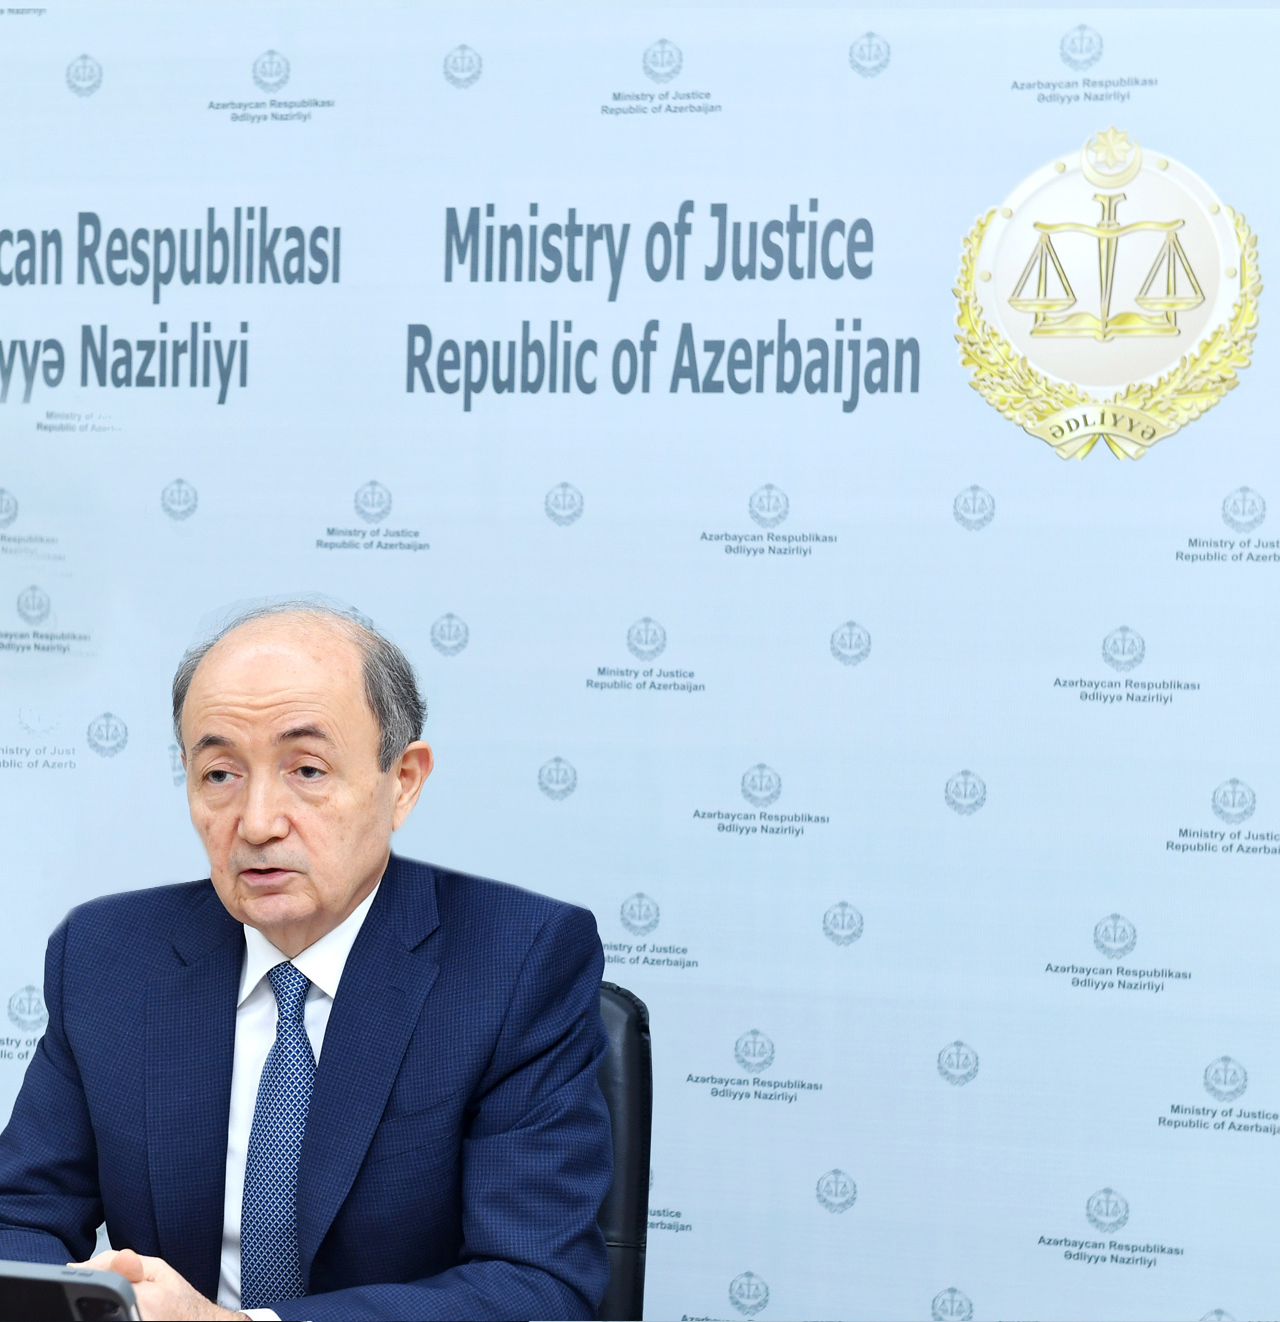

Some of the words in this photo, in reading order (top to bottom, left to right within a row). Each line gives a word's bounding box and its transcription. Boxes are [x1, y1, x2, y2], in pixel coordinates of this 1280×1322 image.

[1084, 91, 1130, 102] Nazirliyi
[77, 206, 341, 304] Respublikası
[444, 202, 631, 302] Ministry
[645, 201, 694, 282] of
[705, 199, 874, 282] Justice
[81, 321, 248, 404] Nazirliyi
[406, 320, 597, 412] Republic
[612, 319, 660, 394] of
[669, 318, 920, 414] Azerbaijan
[1048, 412, 1156, 442] ƏDLİYYƏ
[327, 528, 367, 538] Ministry
[371, 528, 380, 537] of
[383, 528, 420, 538] Justice
[316, 540, 360, 550] Republic
[364, 540, 373, 548] of
[377, 541, 430, 551] Azerbaijan
[597, 667, 639, 678] Ministry
[643, 668, 653, 677] of
[656, 669, 694, 679] Justice
[586, 680, 631, 690] Republic
[636, 681, 645, 690] of
[649, 681, 705, 693] Azerbaijan
[1125, 679, 1200, 690] Respublikası
[1126, 693, 1173, 704] Nazirliyi
